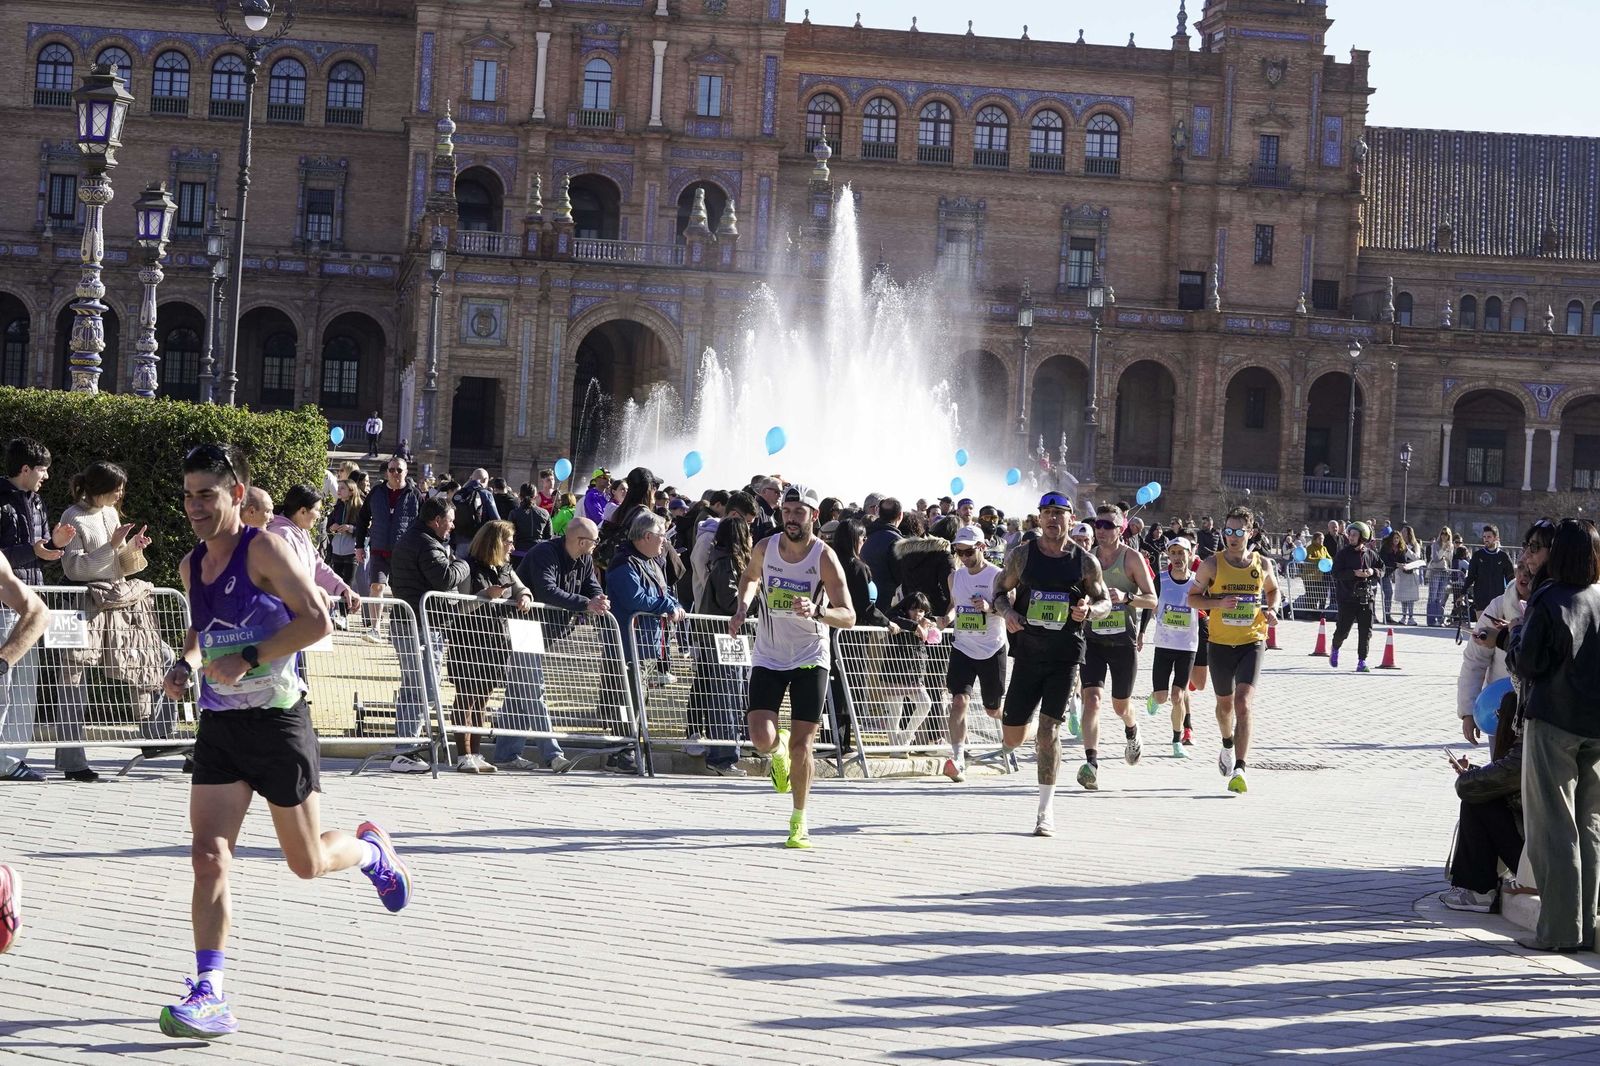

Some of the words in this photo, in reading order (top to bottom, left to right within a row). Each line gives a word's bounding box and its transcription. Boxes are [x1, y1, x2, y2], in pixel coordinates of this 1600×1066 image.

[1227, 583, 1255, 591] STRAGGLERS
[1041, 612, 1054, 620] MD
[53, 614, 78, 631] AMS
[1166, 618, 1186, 626] DANIEL
[216, 630, 254, 644] ZURICH
[722, 637, 741, 652] AMS
